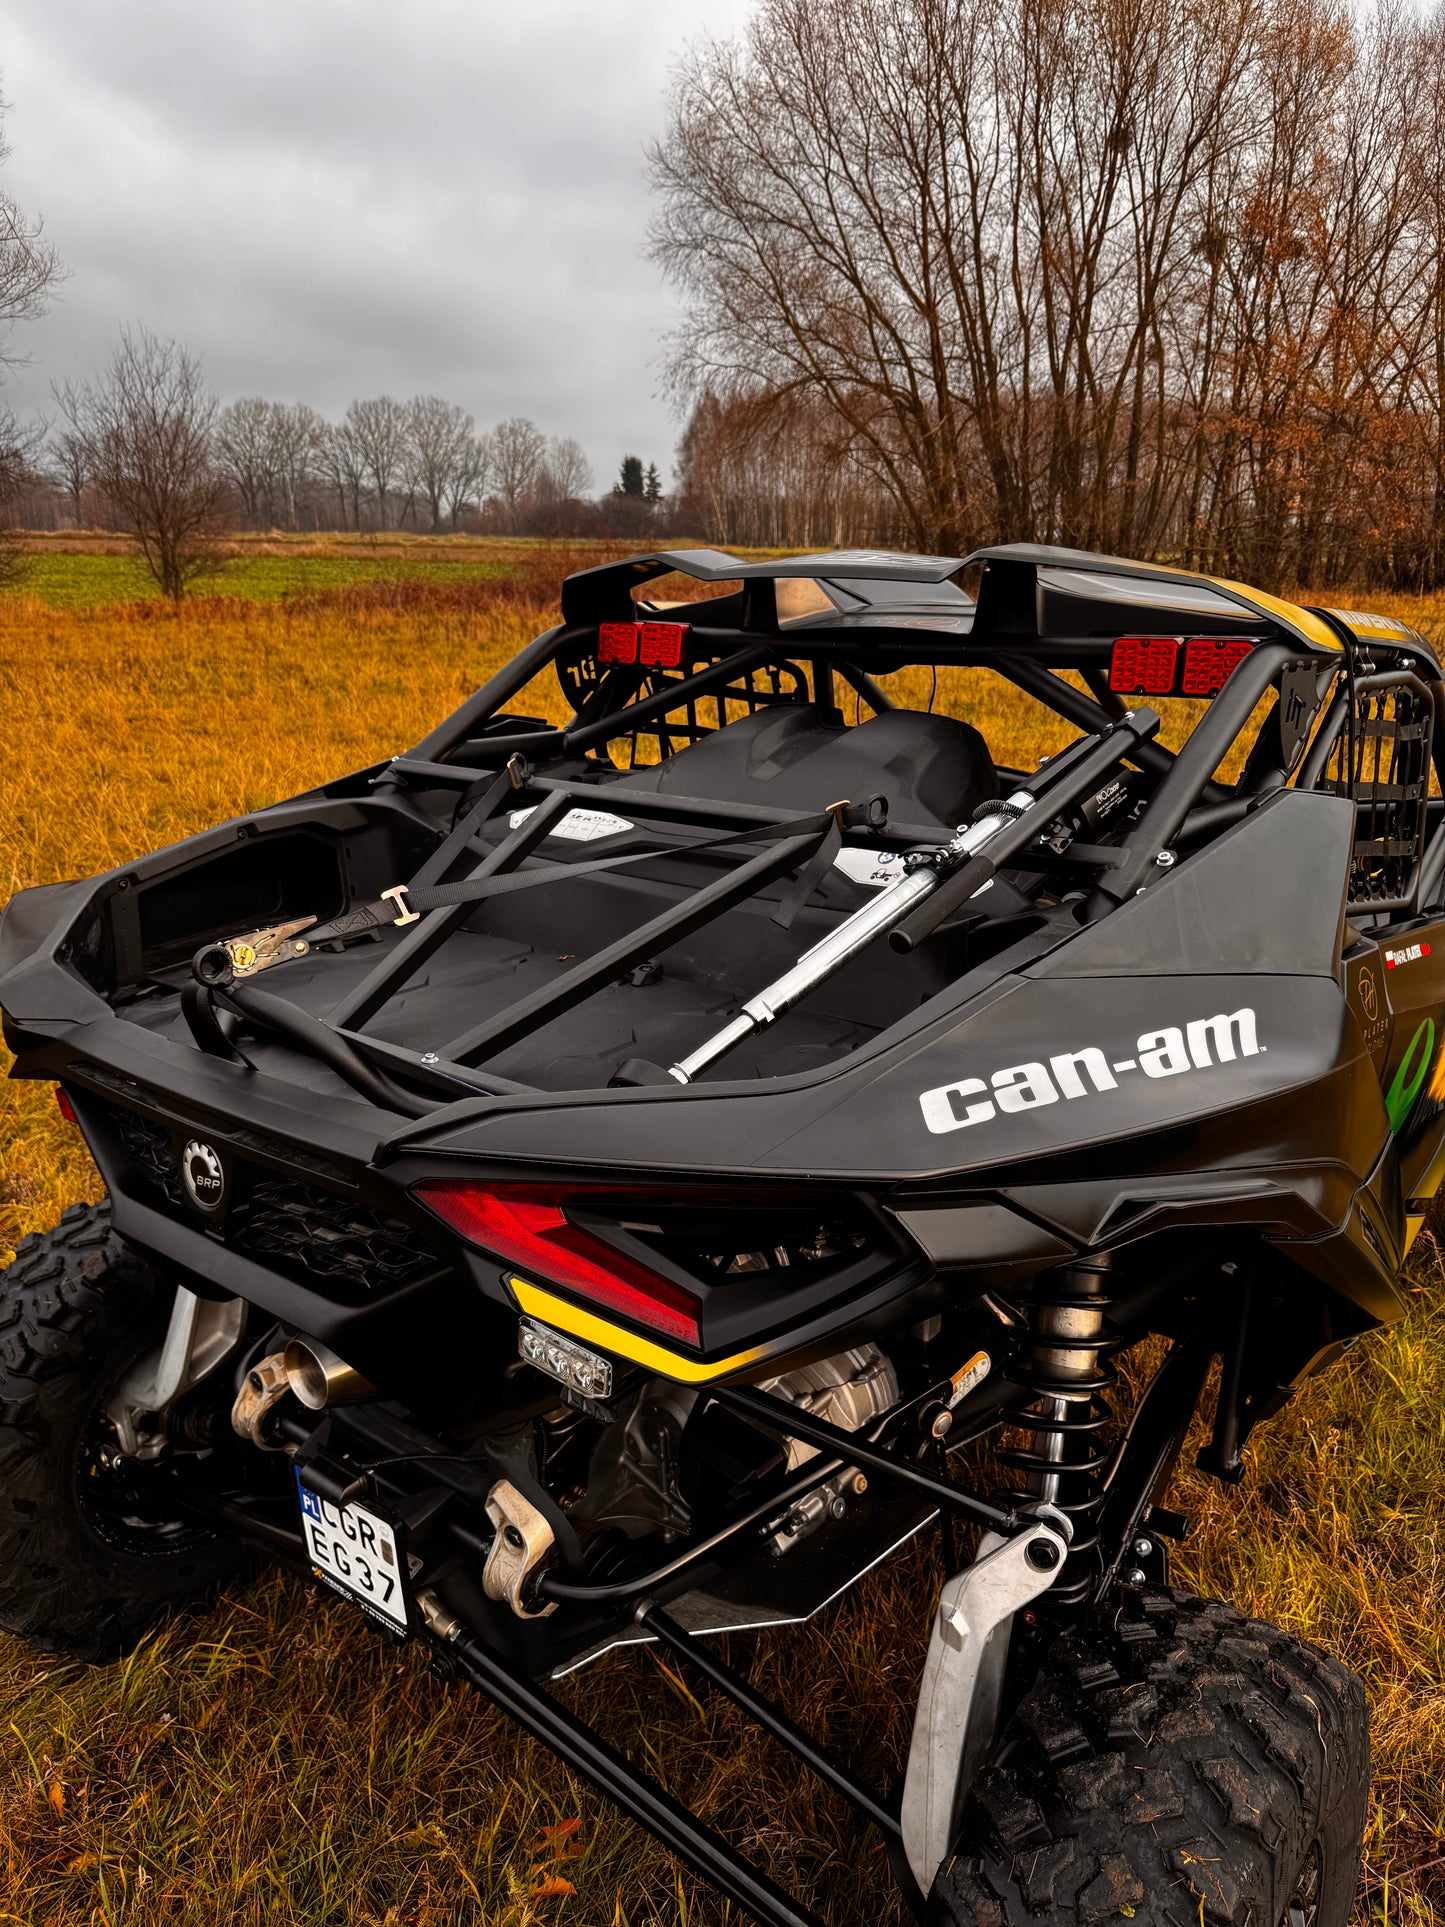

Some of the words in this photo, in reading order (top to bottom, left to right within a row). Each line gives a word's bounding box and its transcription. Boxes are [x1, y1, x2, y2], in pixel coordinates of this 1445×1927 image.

[919, 1008, 1260, 1134] can-am
[196, 1174, 221, 1189] BRP
[303, 1494, 321, 1518] PL
[311, 1523, 395, 1604] EG37
